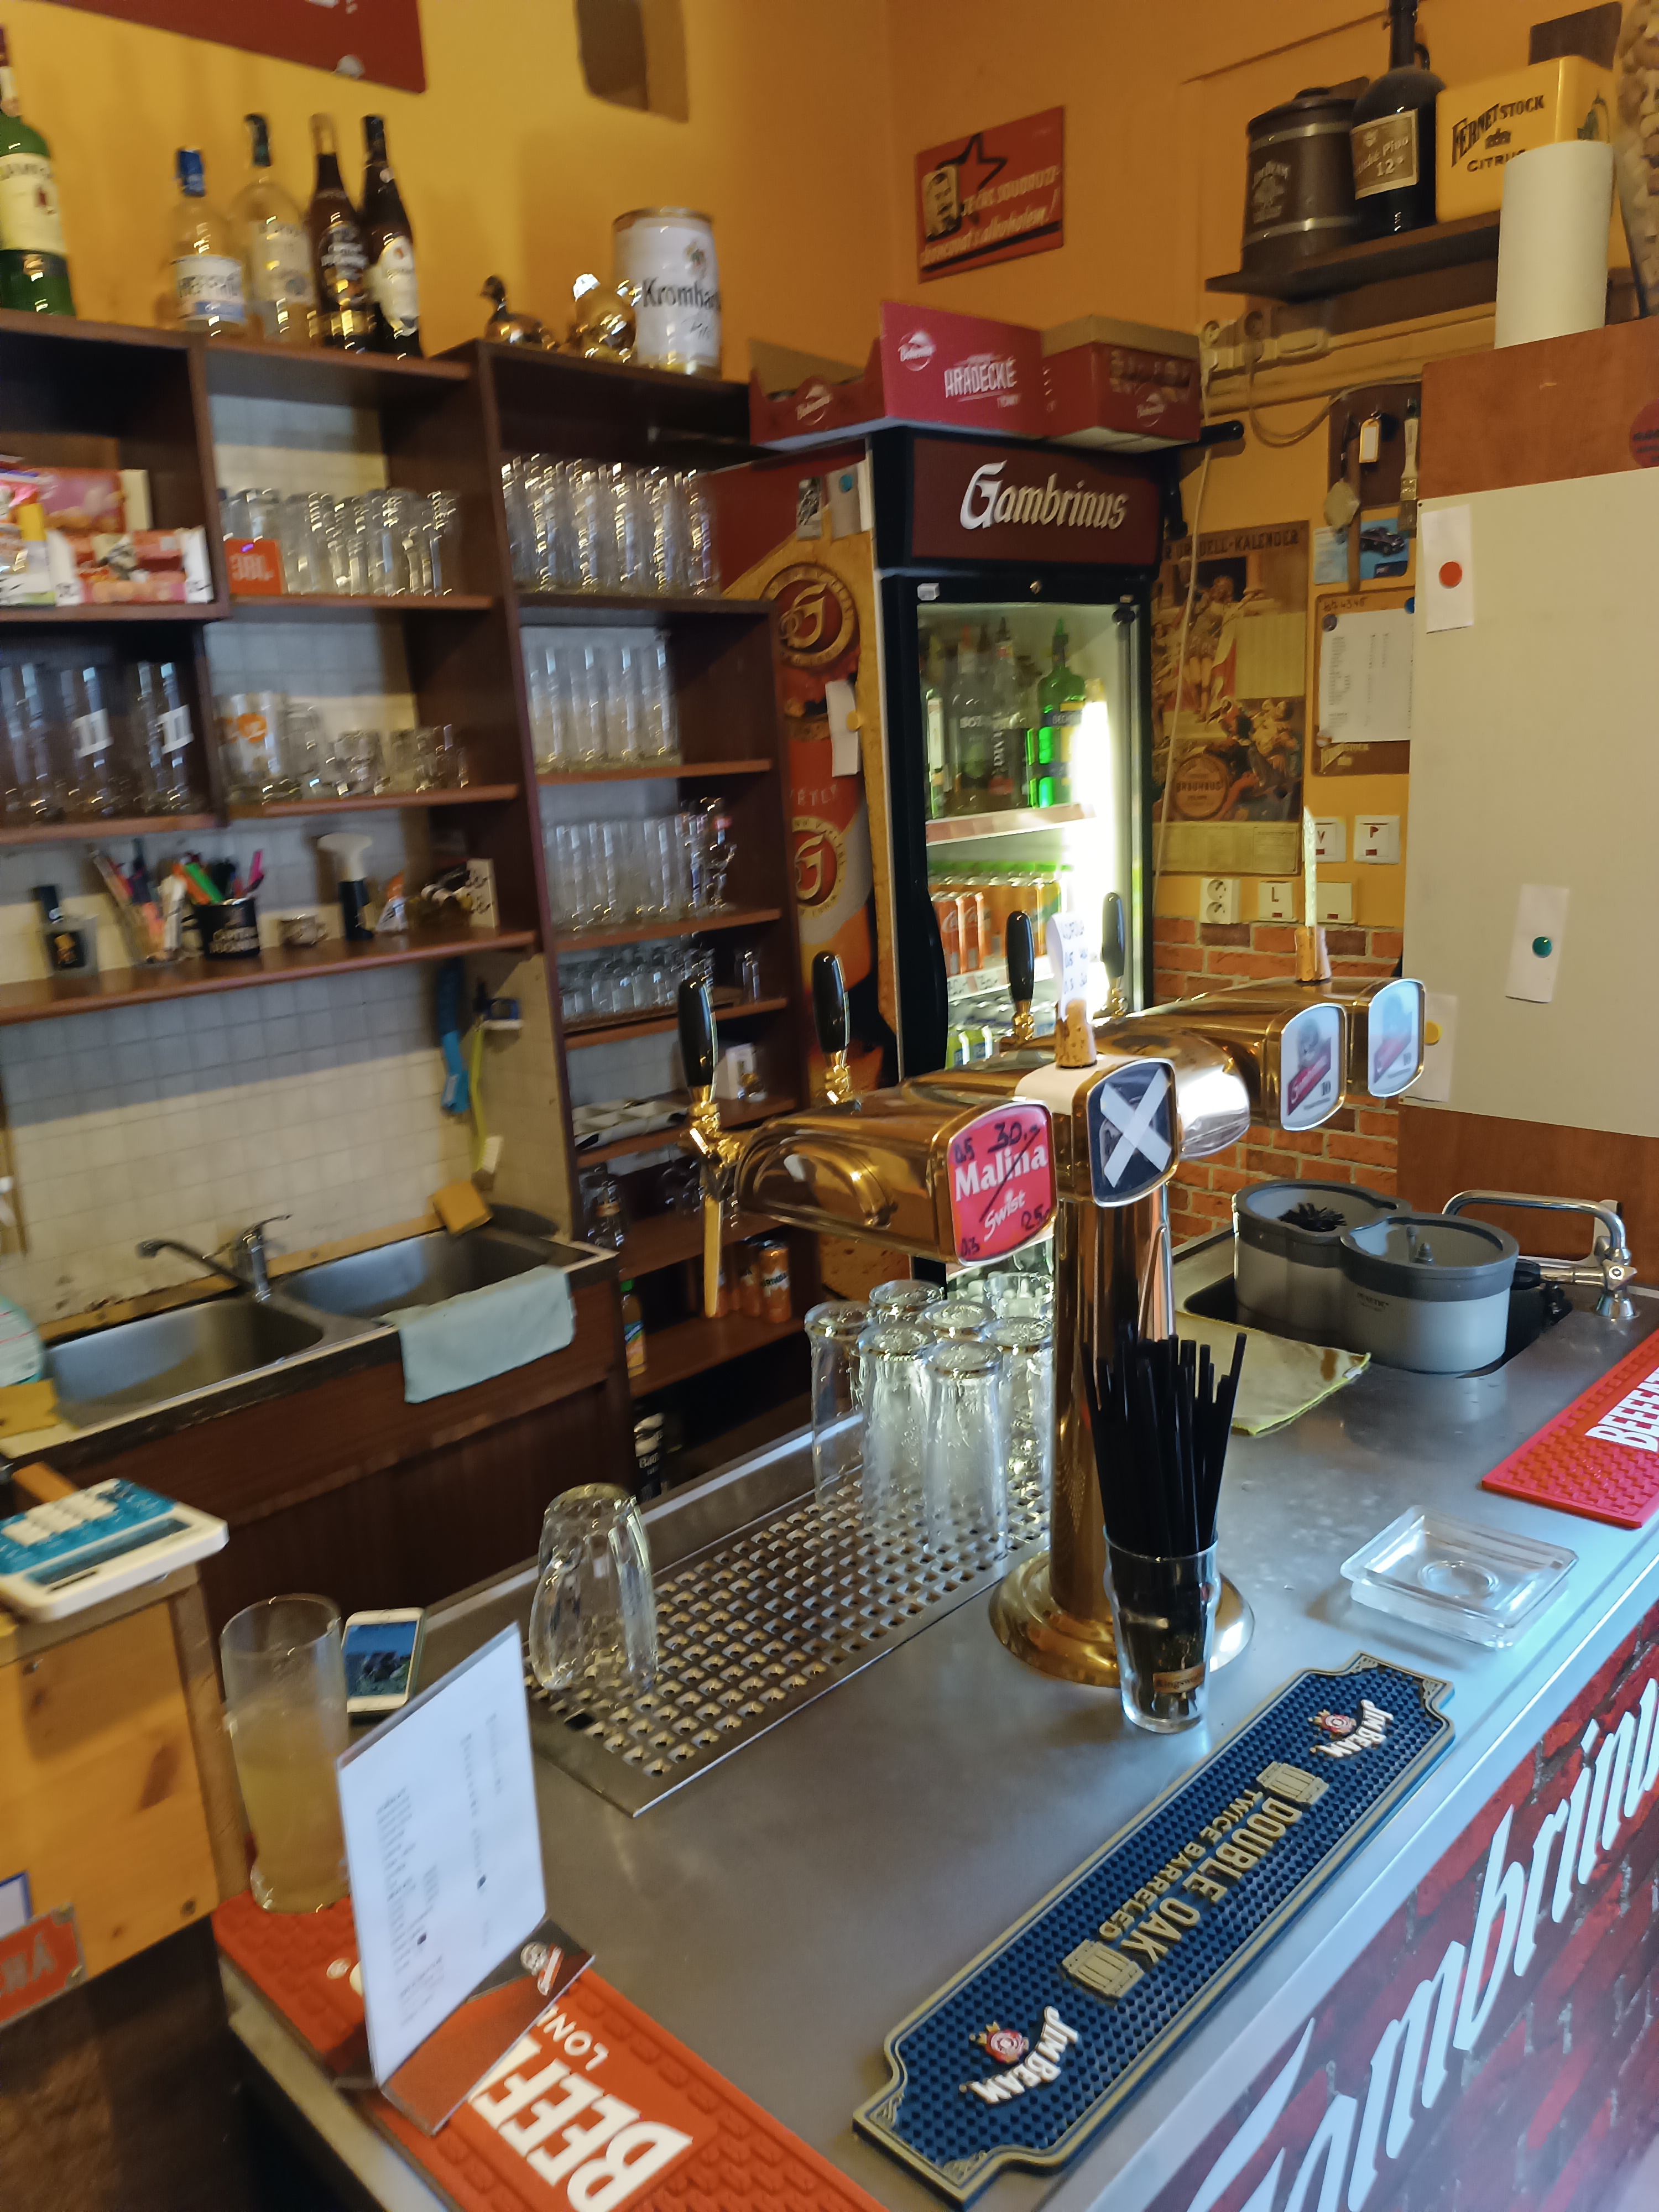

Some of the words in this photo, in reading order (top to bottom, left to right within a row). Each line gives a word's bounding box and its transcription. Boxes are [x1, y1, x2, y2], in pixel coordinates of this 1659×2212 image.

[1451, 103, 1500, 168] FERNET
[1499, 95, 1545, 120] STOCK
[960, 460, 1129, 530] Gambrinus
[1369, 826, 1379, 838] P
[1271, 887, 1279, 902] L
[954, 1144, 1049, 1202] Malina
[1315, 1725, 1386, 1758] BEAM
[1199, 1788, 1264, 1845] TWICE
[1182, 1796, 1303, 1905] DOUBLE
[1098, 1840, 1207, 1940] BARRELED
[1119, 1897, 1201, 1964] OAK
[536, 2005, 609, 2072] LON
[967, 2050, 1062, 2105] BEAM
[468, 2035, 693, 2212] BEEF
